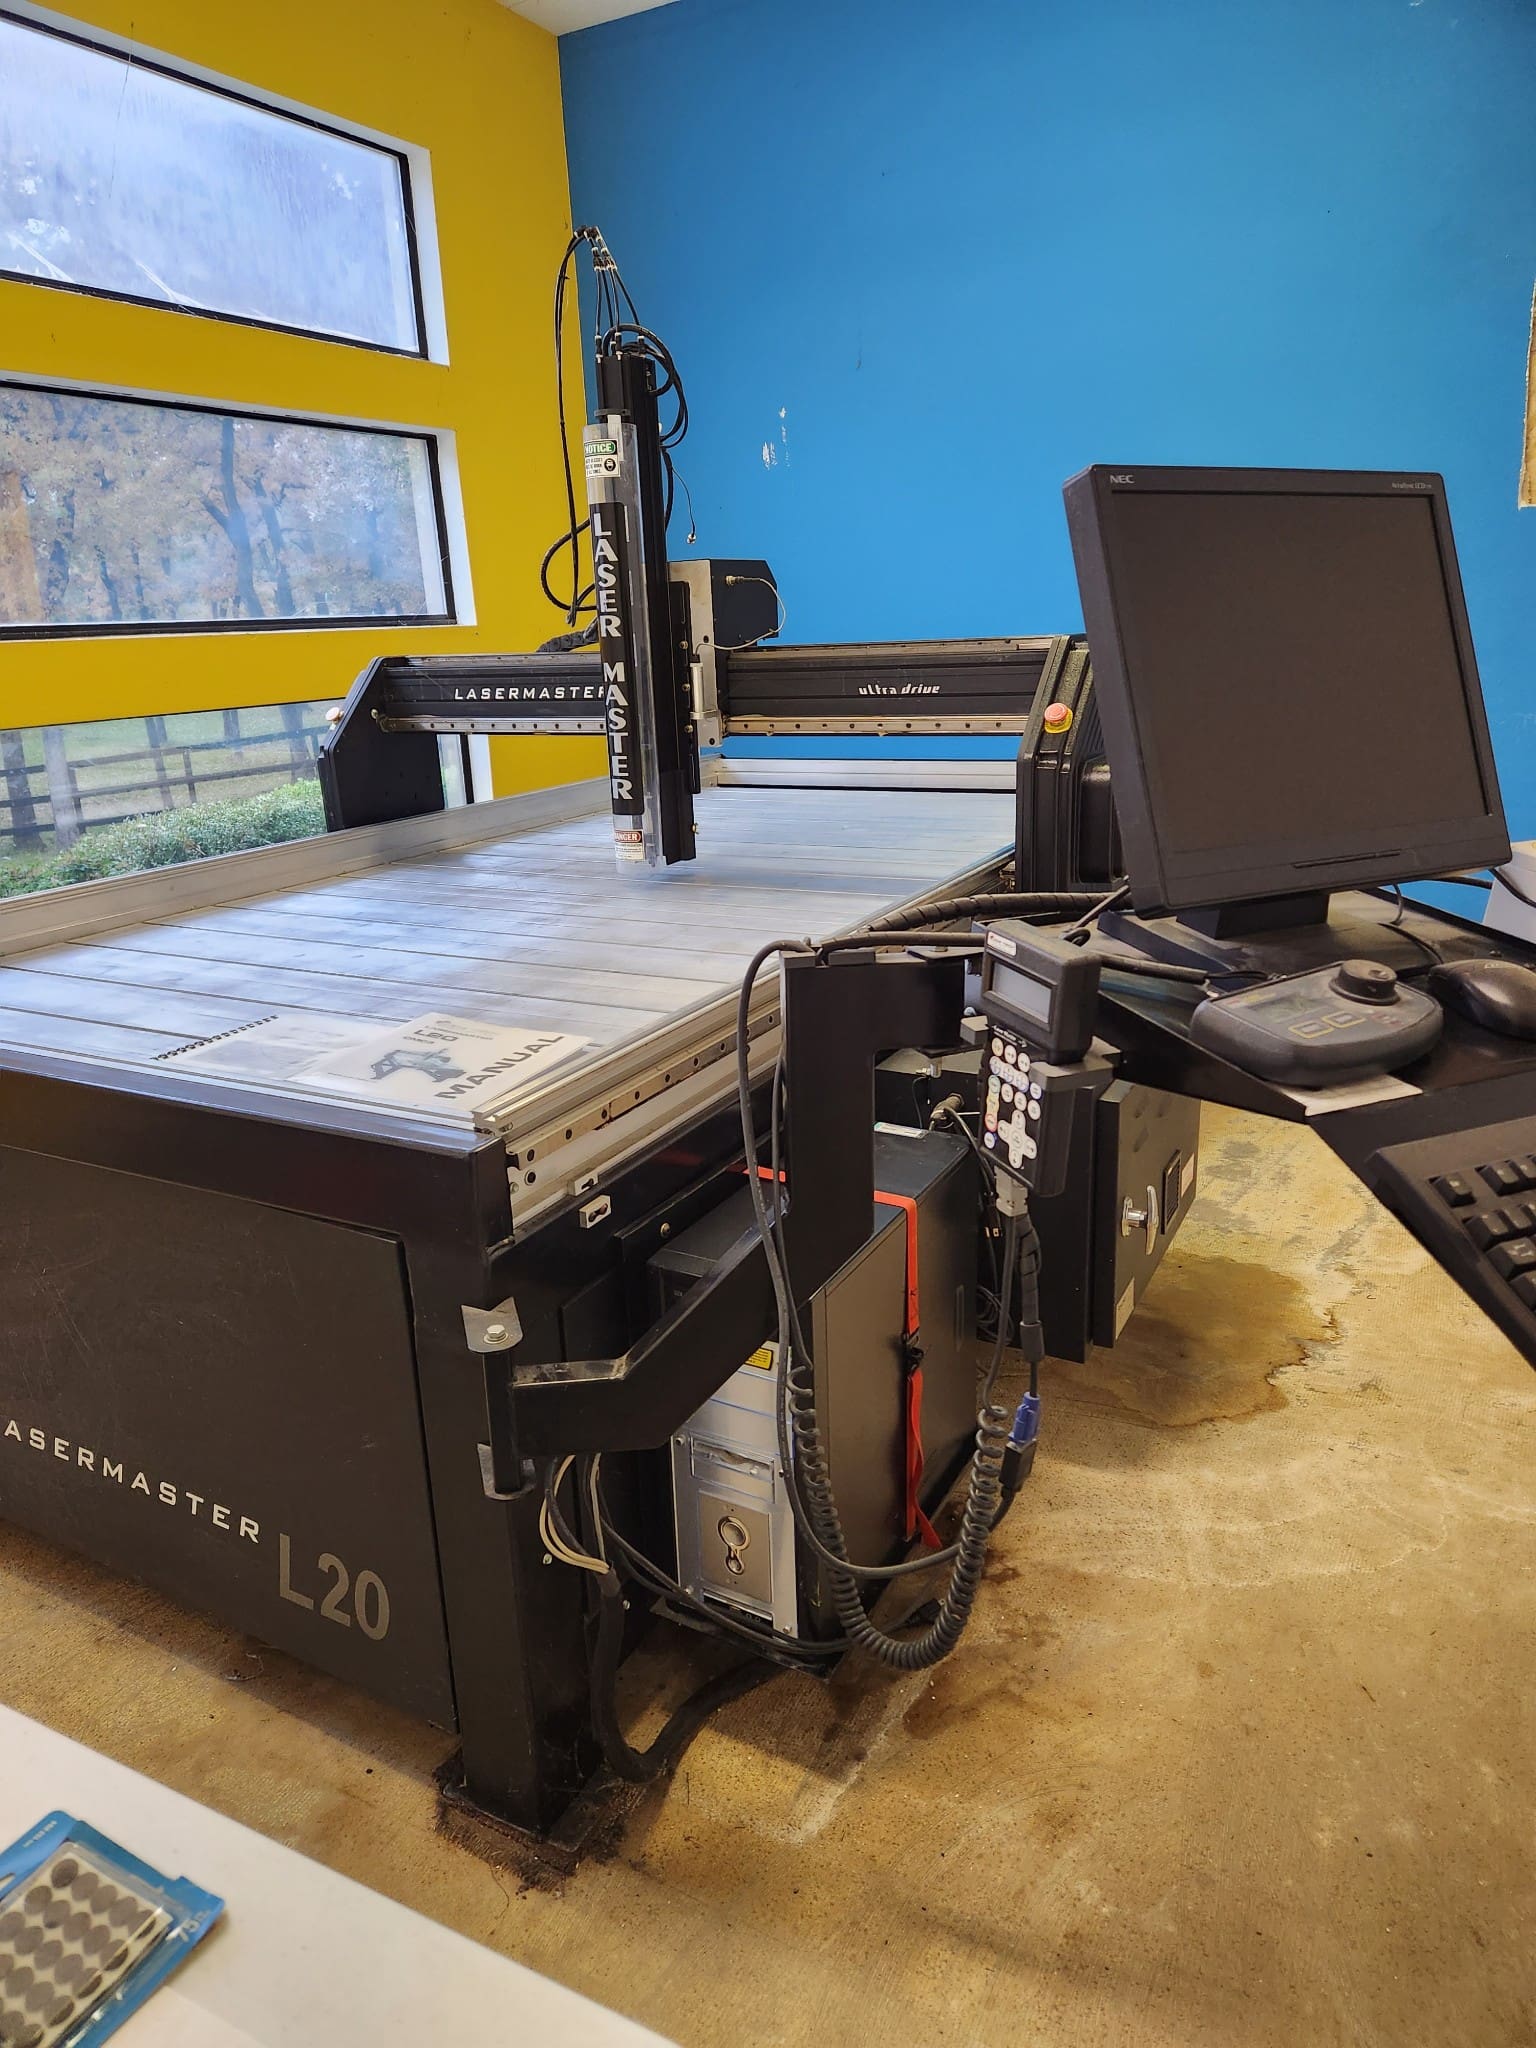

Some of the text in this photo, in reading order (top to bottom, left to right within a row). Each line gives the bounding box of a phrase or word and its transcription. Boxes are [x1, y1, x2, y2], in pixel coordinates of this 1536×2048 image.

[1110, 474, 1135, 484] NEC
[593, 512, 633, 800] LASER MASTER
[858, 683, 940, 695] ultra drive
[434, 1036, 564, 1099] MANUAL
[279, 1532, 391, 1641] L20
